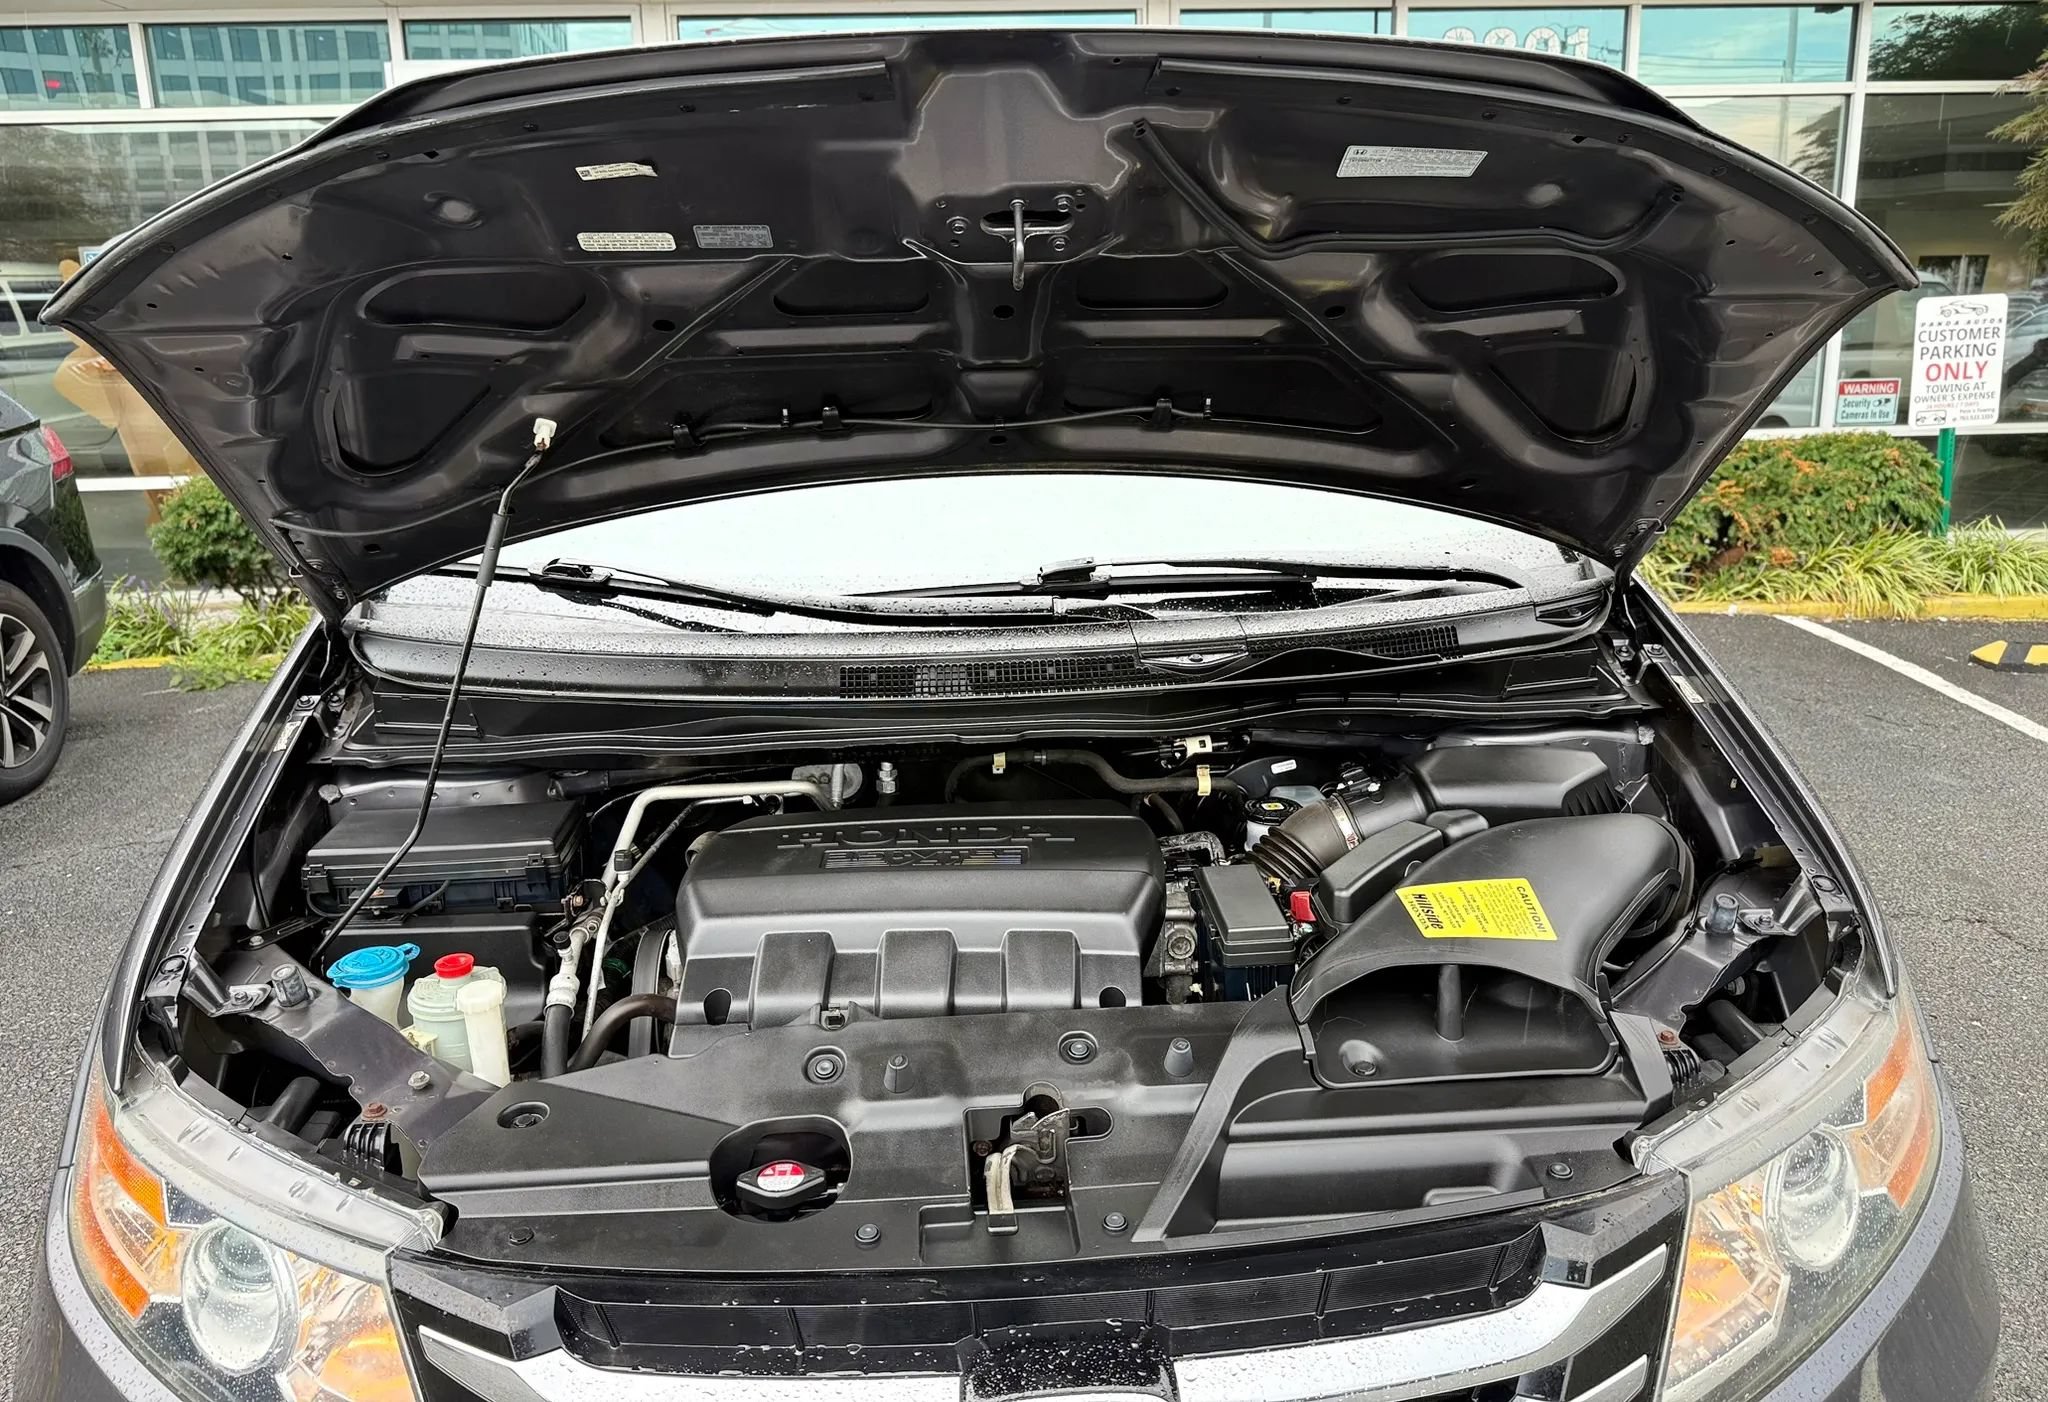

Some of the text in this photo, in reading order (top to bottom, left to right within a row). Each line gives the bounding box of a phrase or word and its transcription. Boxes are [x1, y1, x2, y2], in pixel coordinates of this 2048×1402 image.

[1921, 317, 2003, 328] PANDA AUTOS
[1918, 327, 2000, 343] CUSTOMER
[1920, 342, 1996, 360] PARKING
[1925, 360, 1989, 382] ONLY
[1843, 382, 1894, 394] WARNING
[1926, 381, 1986, 394] TOWING AT
[1843, 397, 1871, 409] Security
[1958, 391, 1996, 401] EXPENSE
[1841, 408, 1890, 420] Cameras In Use
[777, 825, 1075, 849] HONDA
[1408, 900, 1430, 930] HONDA
[1412, 893, 1444, 929] Hillside
[1516, 886, 1547, 933] CAUTION!
